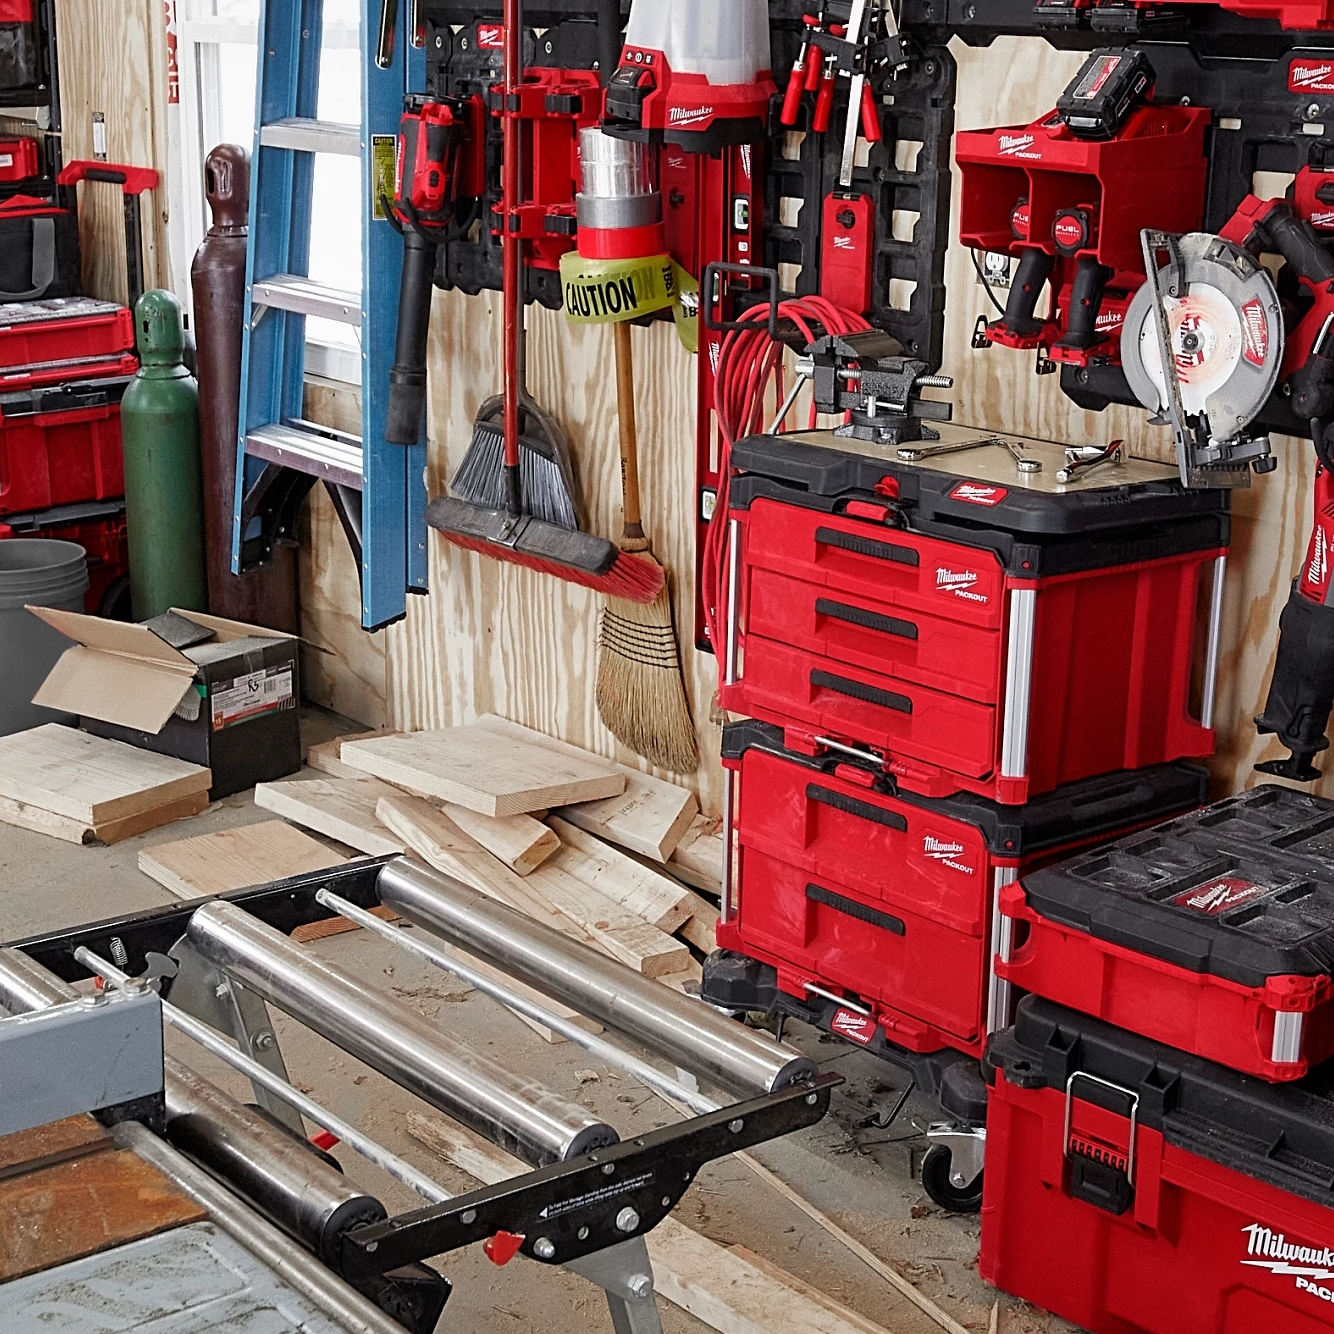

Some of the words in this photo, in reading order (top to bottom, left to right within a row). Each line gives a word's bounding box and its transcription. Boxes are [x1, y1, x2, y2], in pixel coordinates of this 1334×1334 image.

[1293, 64, 1332, 82] Milwaukee
[668, 105, 713, 122] Milwaukee
[998, 134, 1035, 150] Milwaukee
[1056, 225, 1080, 233] FUEL
[566, 276, 638, 318] CAUTION
[1245, 303, 1265, 358] Milwaukee
[1308, 525, 1322, 584] Milwaukee
[935, 567, 977, 584] Milwaukee
[955, 589, 988, 603] PACKOUT
[923, 835, 964, 852] Milwaukee
[942, 858, 974, 874] PACKOUT
[835, 1011, 867, 1026] Milwaukee
[846, 1028, 869, 1042] PACKOUT
